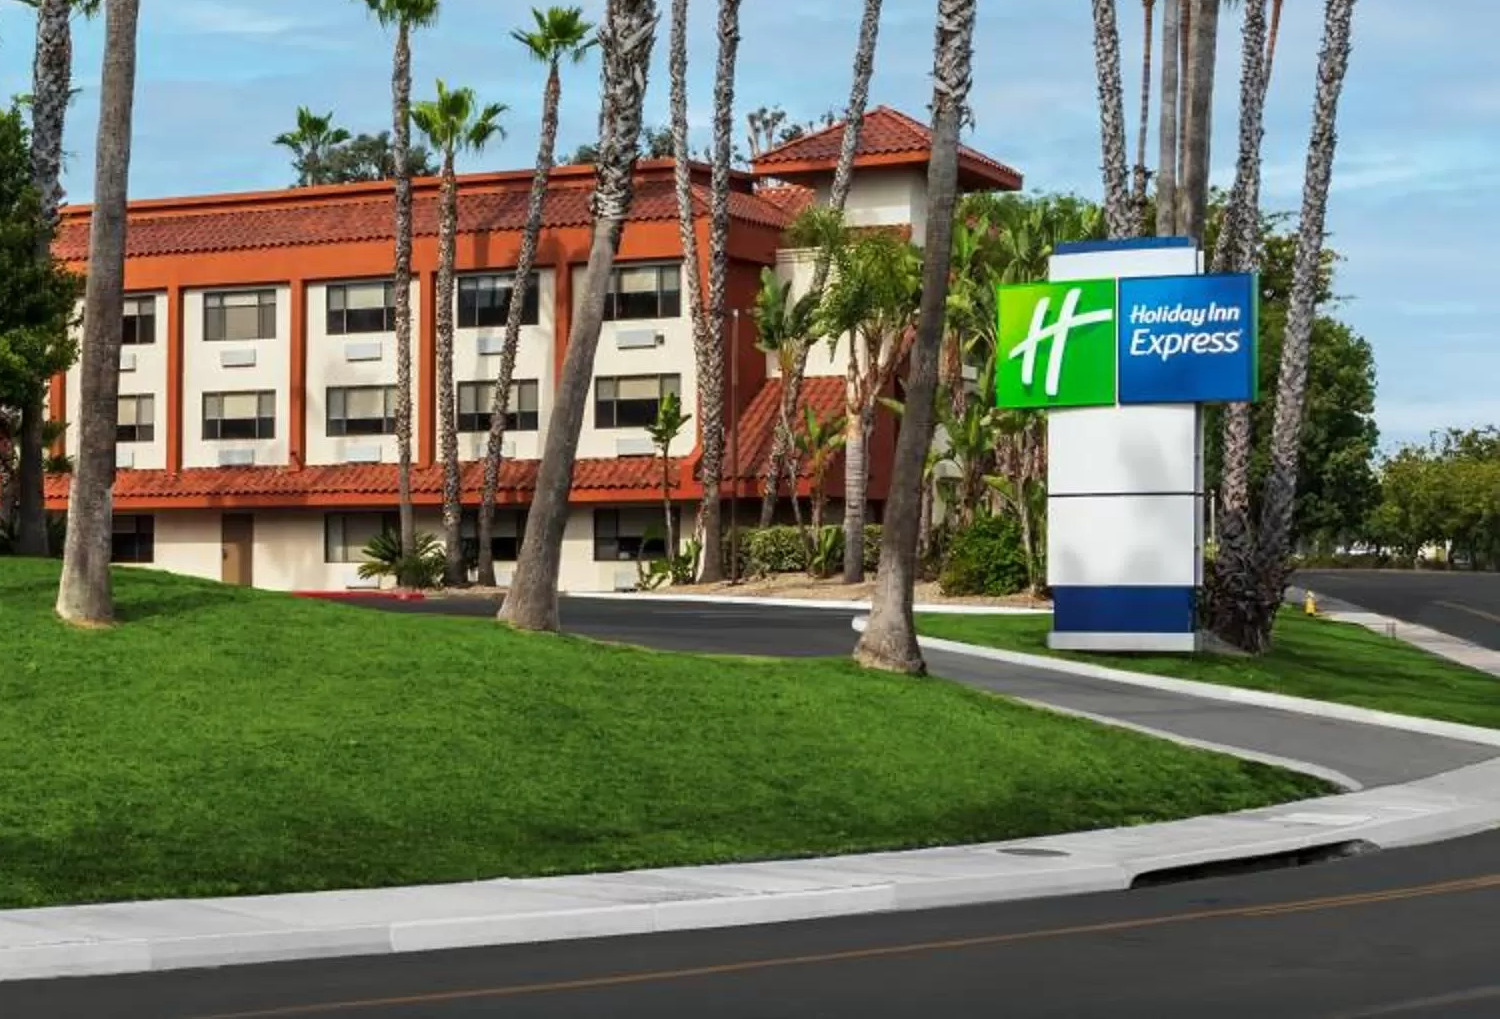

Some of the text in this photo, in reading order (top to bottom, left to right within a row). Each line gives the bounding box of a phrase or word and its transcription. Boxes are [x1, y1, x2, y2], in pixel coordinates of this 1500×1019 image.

[1128, 300, 1241, 327] Holiday Inn
[1129, 328, 1241, 362] Express
